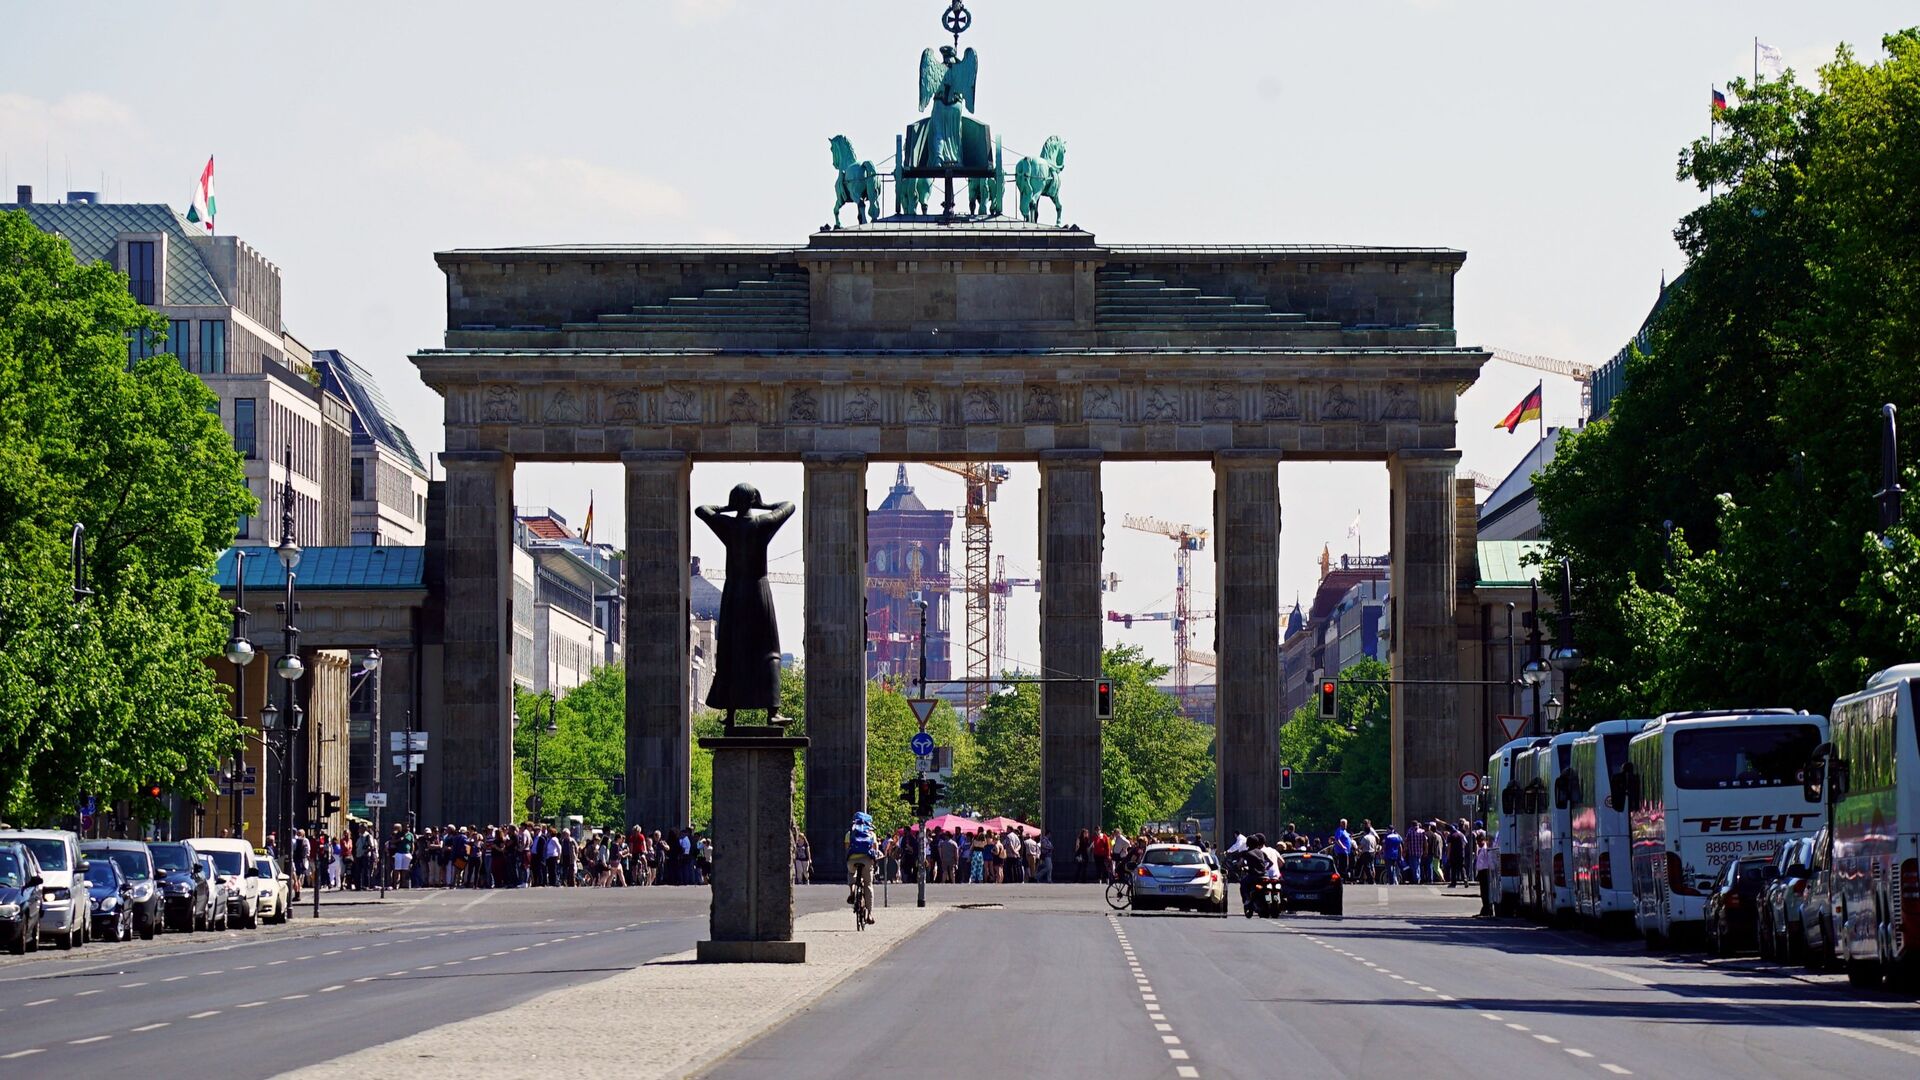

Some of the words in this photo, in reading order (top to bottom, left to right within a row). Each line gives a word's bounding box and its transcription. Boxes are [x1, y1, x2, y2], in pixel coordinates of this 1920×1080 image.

[1719, 779, 1782, 787] SETRA
[1683, 814, 1821, 832] FECHT
[1706, 841, 1743, 853] 88605
[1748, 839, 1784, 852] Meßk
